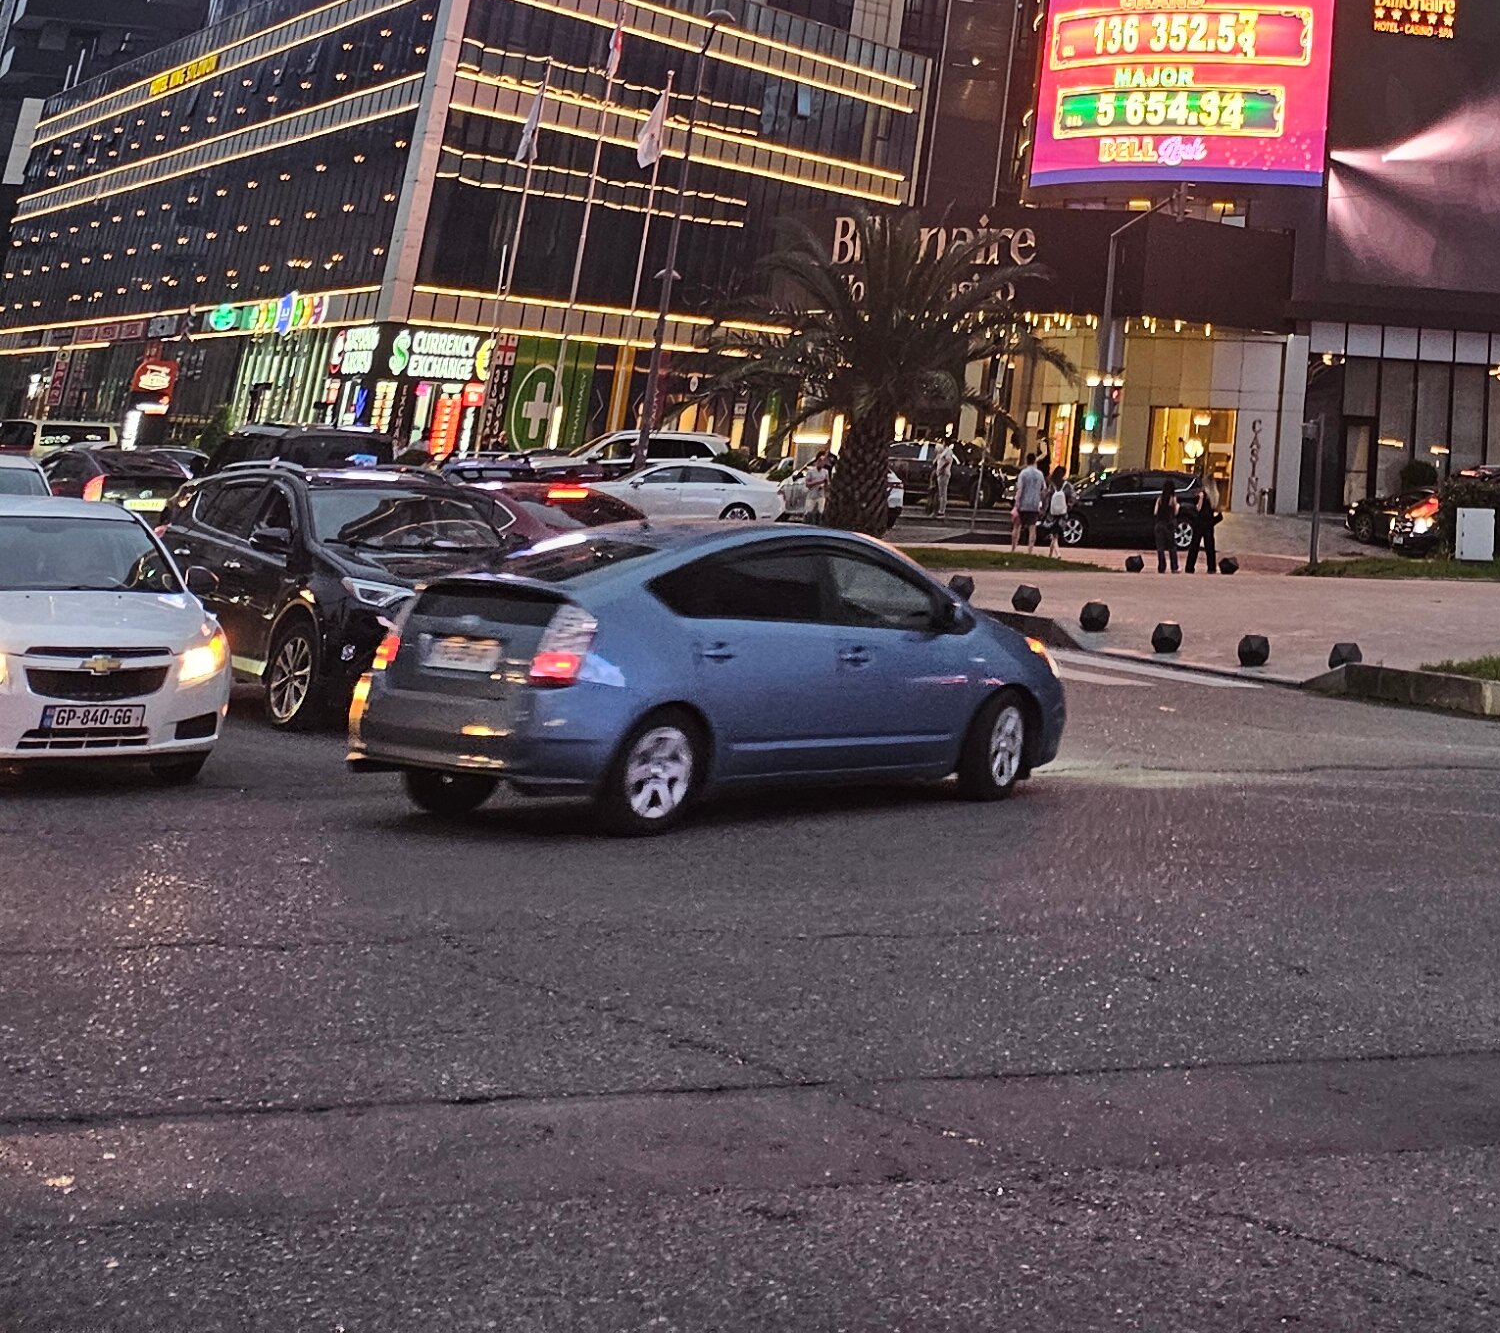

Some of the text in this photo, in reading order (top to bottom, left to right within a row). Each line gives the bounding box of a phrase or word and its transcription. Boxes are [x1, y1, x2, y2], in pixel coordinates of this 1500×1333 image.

[1093, 14, 1140, 55] 136
[1113, 67, 1195, 89] MAJOR
[1098, 137, 1158, 163] BELL
[412, 330, 480, 358] CURRENCY
[407, 354, 475, 381] EXCHANGE
[1245, 419, 1262, 507] CASINO
[55, 708, 133, 726] GP-840-GG
